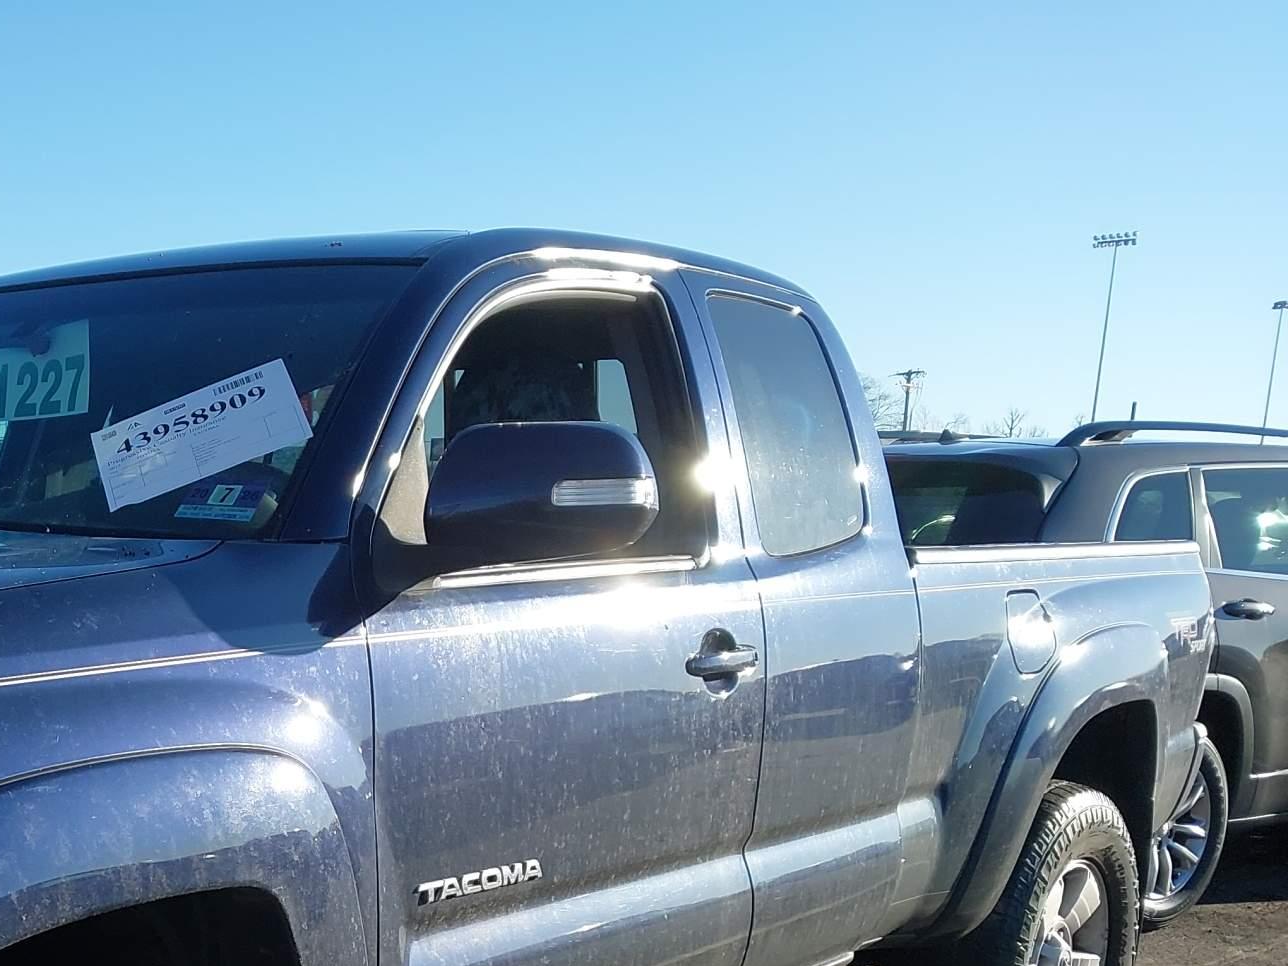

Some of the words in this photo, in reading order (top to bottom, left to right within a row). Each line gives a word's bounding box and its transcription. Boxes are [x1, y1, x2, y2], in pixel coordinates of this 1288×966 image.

[117, 386, 266, 454] 43958909
[219, 487, 235, 503] 7
[416, 858, 543, 906] TACOMA
